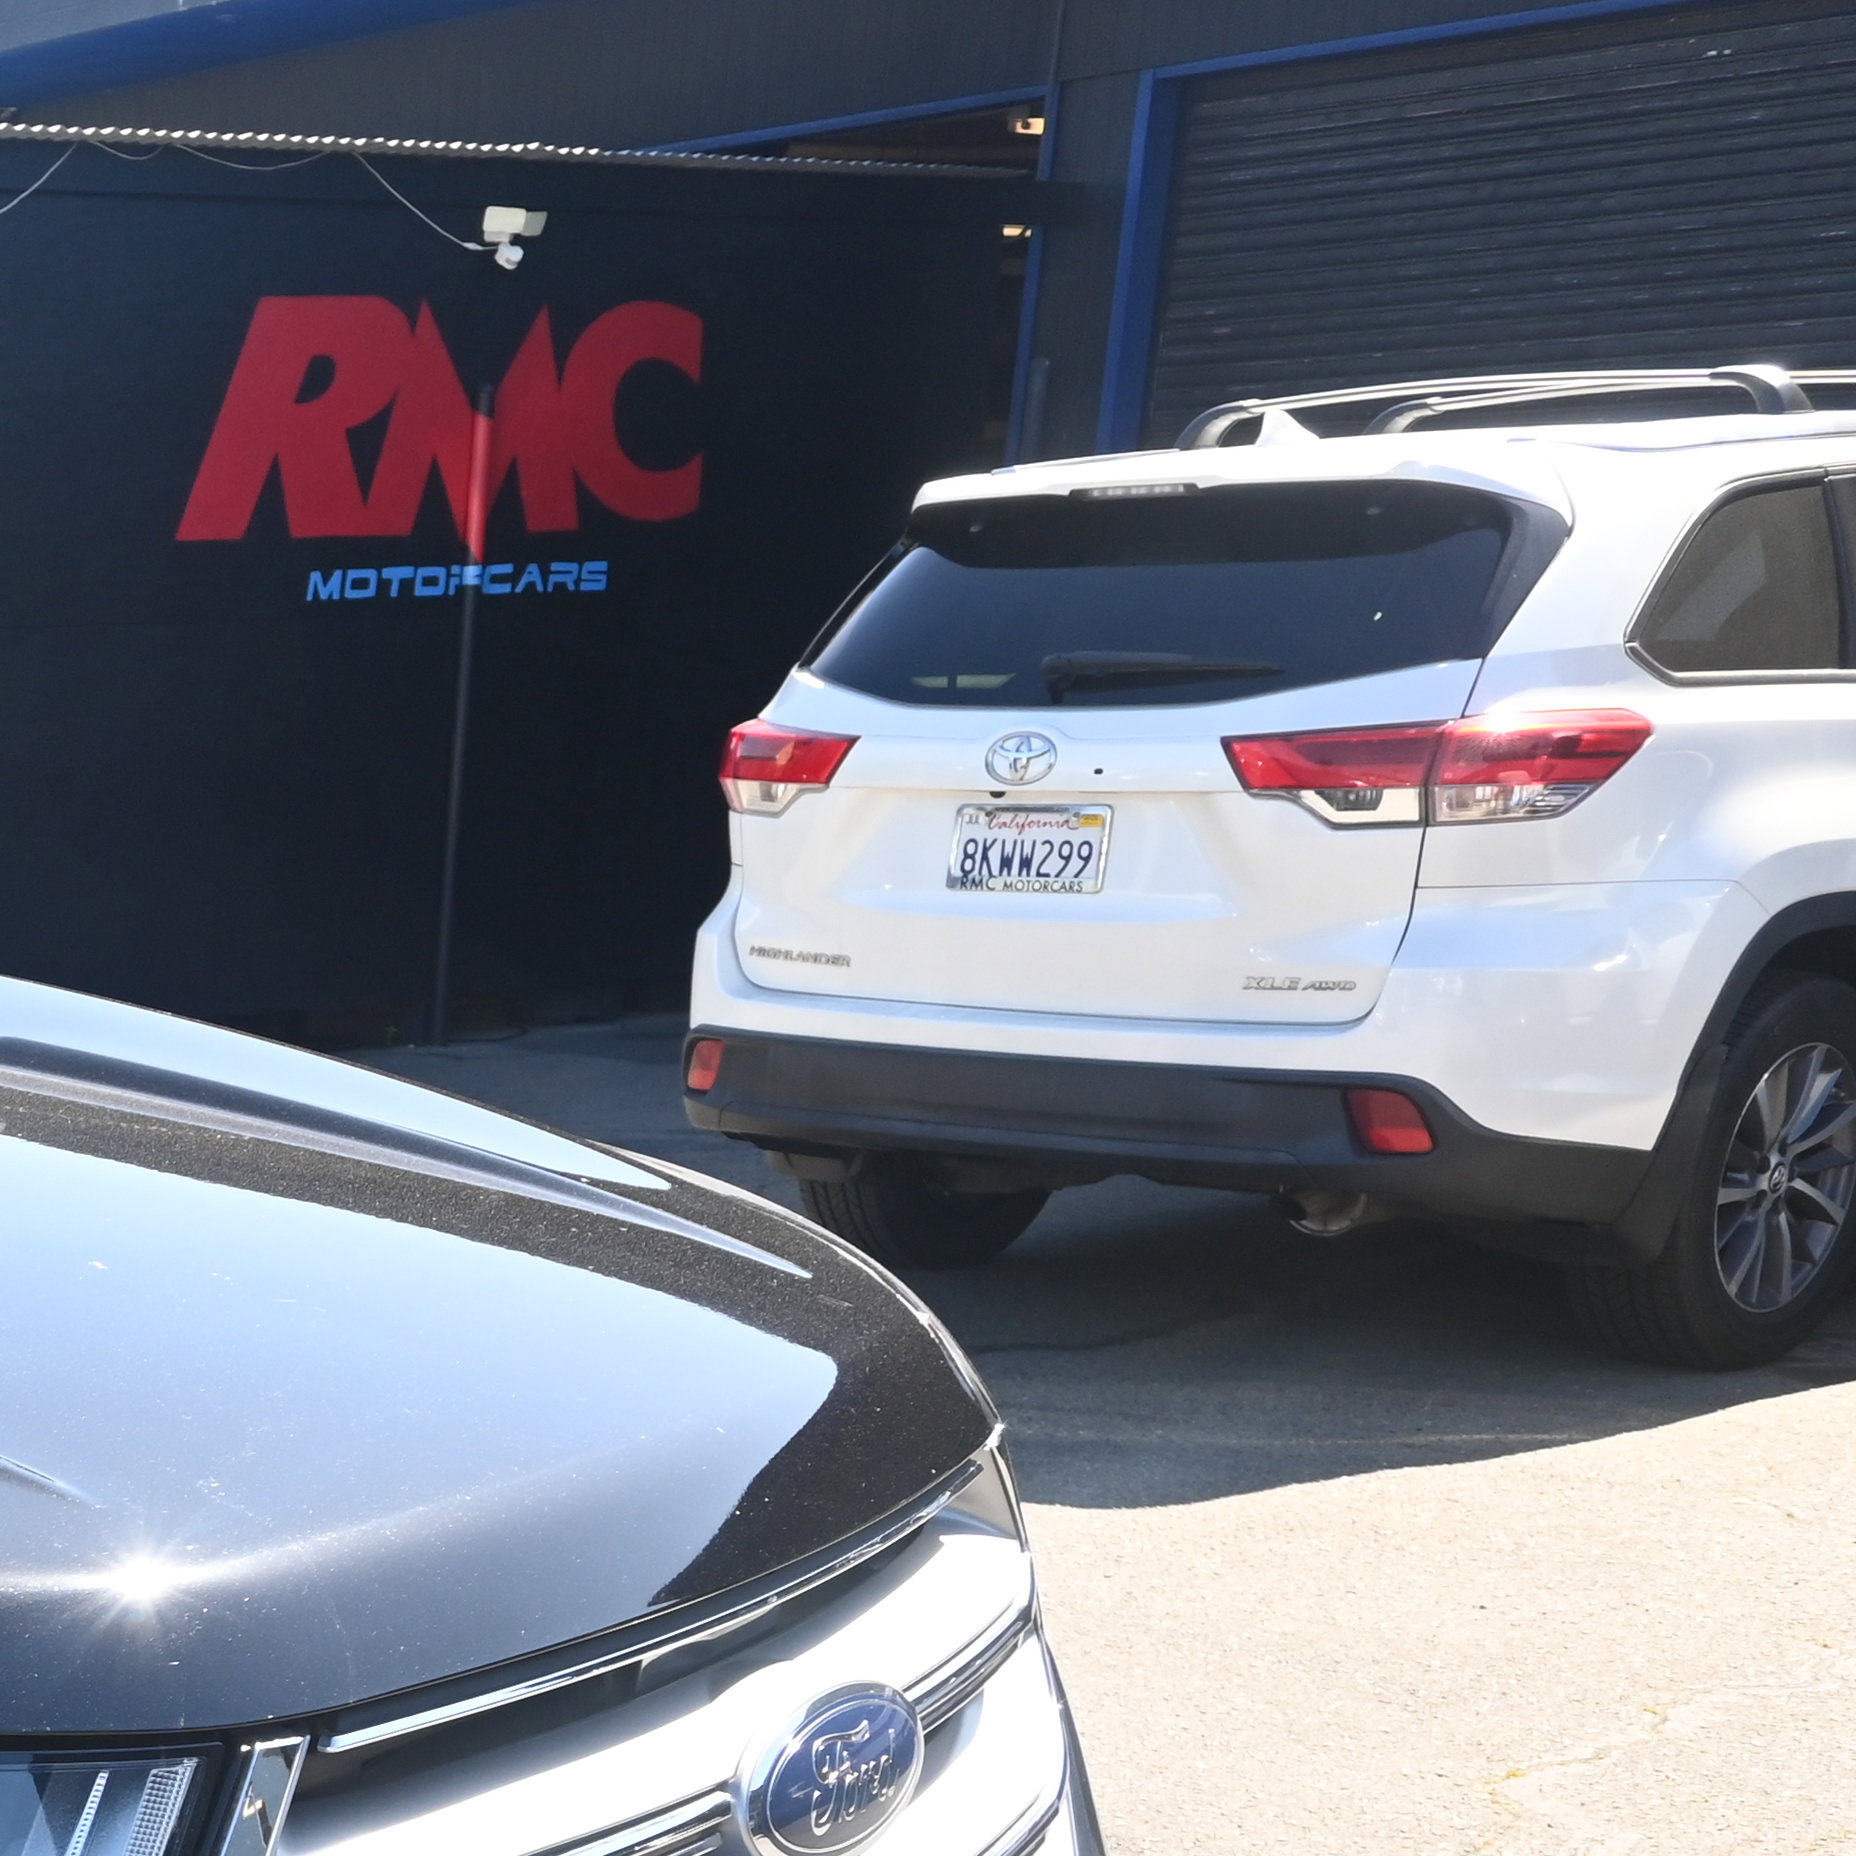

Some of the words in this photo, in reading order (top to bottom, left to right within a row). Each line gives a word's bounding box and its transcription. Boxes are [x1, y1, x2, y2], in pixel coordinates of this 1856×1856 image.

[175, 294, 704, 560] RMC
[987, 812, 1080, 836] California
[960, 837, 1094, 879] 8KWW299
[959, 875, 997, 891] RMC
[1002, 880, 1083, 893] MOTORCARS
[748, 944, 852, 967] HIGHLANDER
[810, 1719, 900, 1836] Ford
